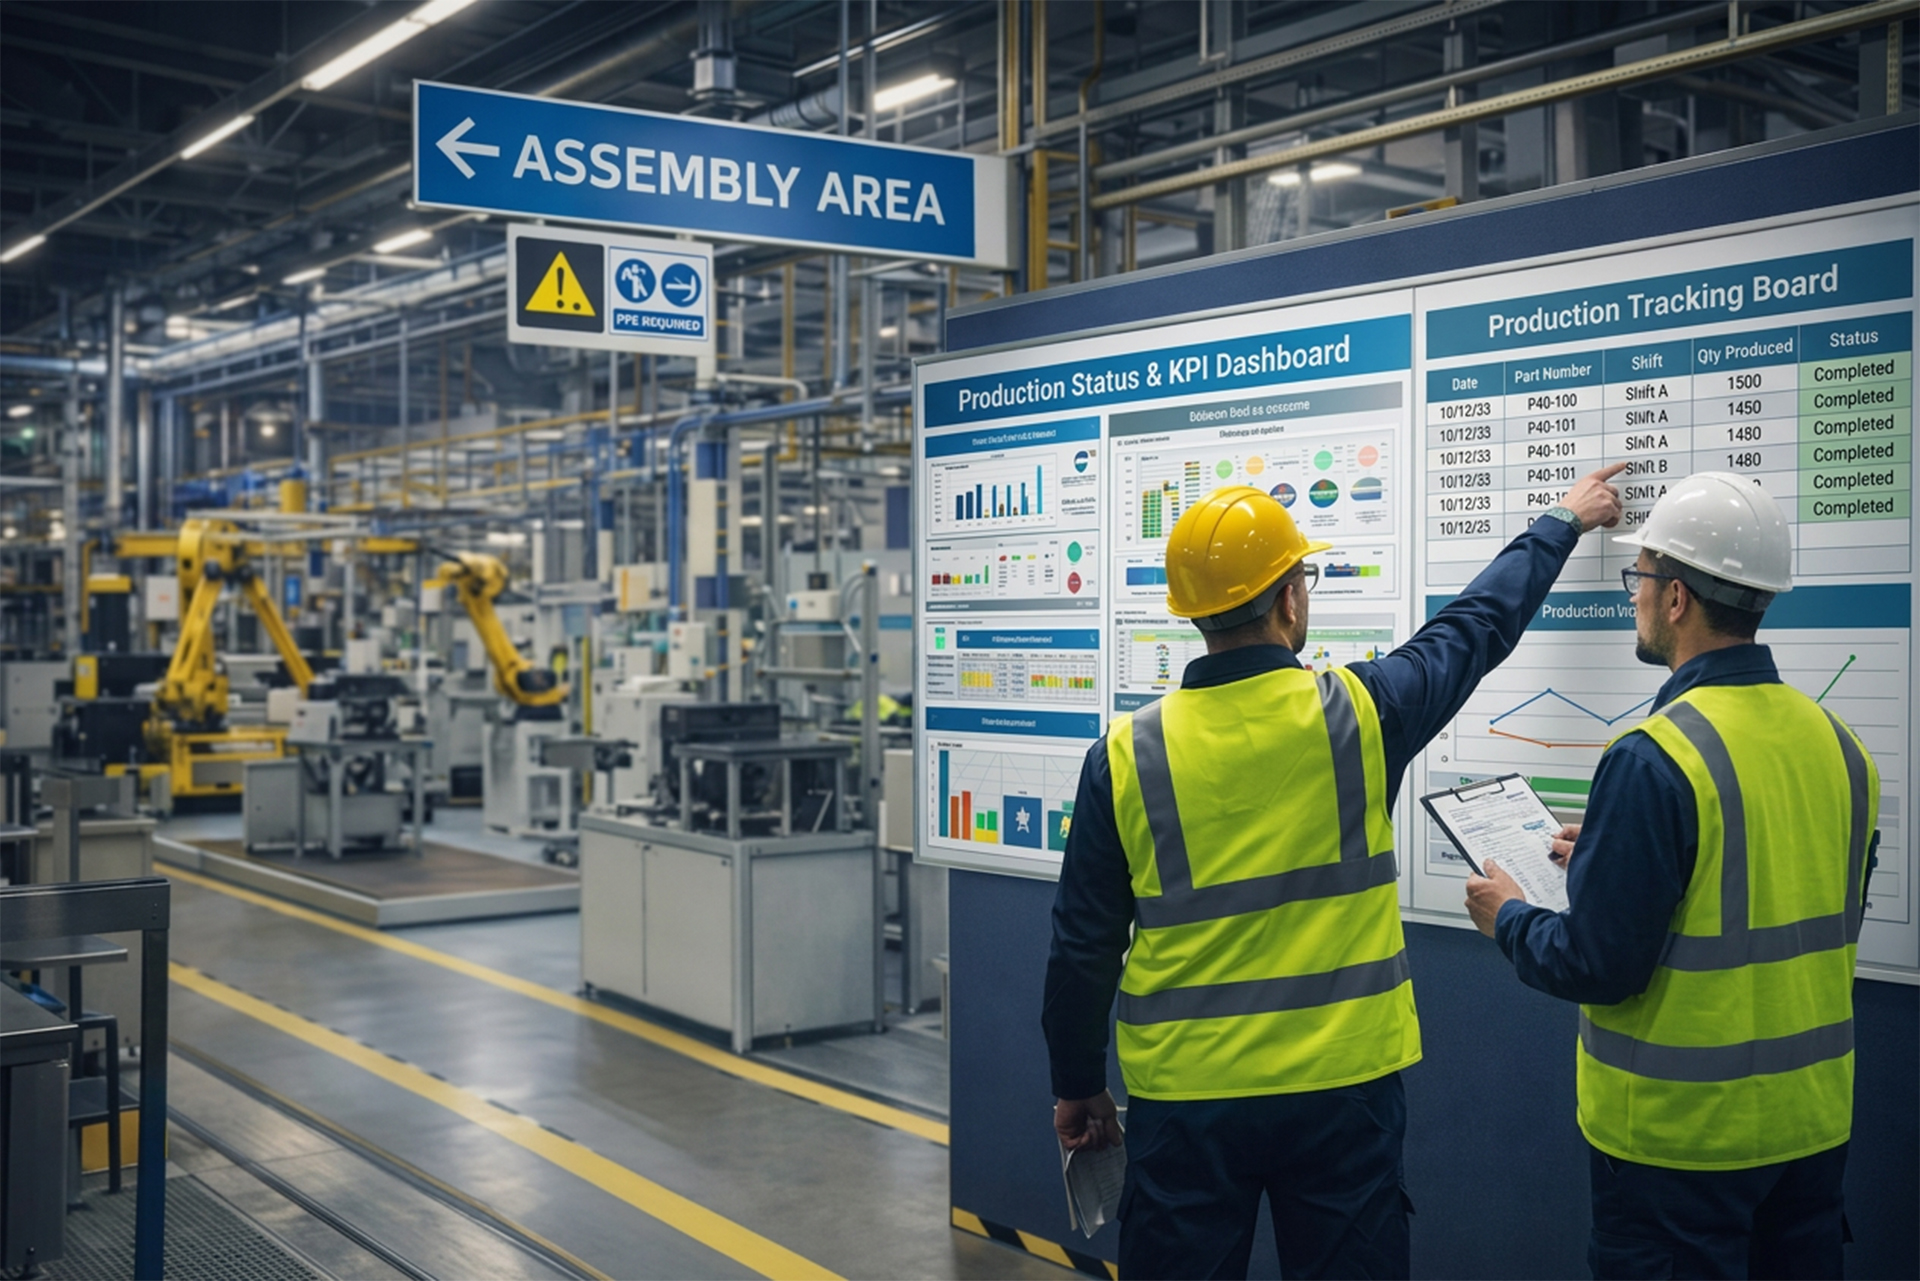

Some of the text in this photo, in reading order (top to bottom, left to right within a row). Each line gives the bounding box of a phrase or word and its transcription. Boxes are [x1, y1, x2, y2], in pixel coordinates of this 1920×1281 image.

[513, 135, 945, 225] ASSEMBLY AREA
[1489, 264, 1838, 338] Production Tracking Board
[616, 313, 639, 326] PPE
[1830, 331, 1879, 348] Status
[1725, 337, 1793, 360] Produced
[959, 334, 1350, 411] Production Status & KPI Dashboard
[1515, 364, 1592, 383] Part Number
[1814, 359, 1894, 382] Completed
[1452, 377, 1478, 391] Date
[1728, 374, 1762, 390] 1500
[1658, 384, 1668, 398] A
[1814, 386, 1894, 409] Completed
[1528, 393, 1577, 410] P40-100
[1728, 400, 1762, 416] 1450
[1440, 402, 1491, 419] 10/12/33
[1658, 409, 1668, 423] A
[1528, 418, 1575, 434] P40-101
[1813, 414, 1894, 436] Completed
[1440, 426, 1491, 442] 10/12/33
[1658, 434, 1668, 448] A
[1727, 426, 1762, 442] 1480
[1440, 449, 1491, 465] 10/12/33
[1528, 442, 1575, 458] P40-101
[1813, 442, 1893, 463] Completed
[1659, 459, 1668, 473] B
[1727, 452, 1762, 468] 1480
[1440, 472, 1491, 489] 10/12/33
[1528, 466, 1575, 482] P40-101
[1813, 469, 1893, 491] Completed
[1658, 485, 1667, 498] A
[1440, 496, 1491, 511] 10/12/33
[1813, 497, 1893, 518] Completed
[1440, 520, 1491, 535] 10/12/25
[1542, 603, 1614, 618] Production
